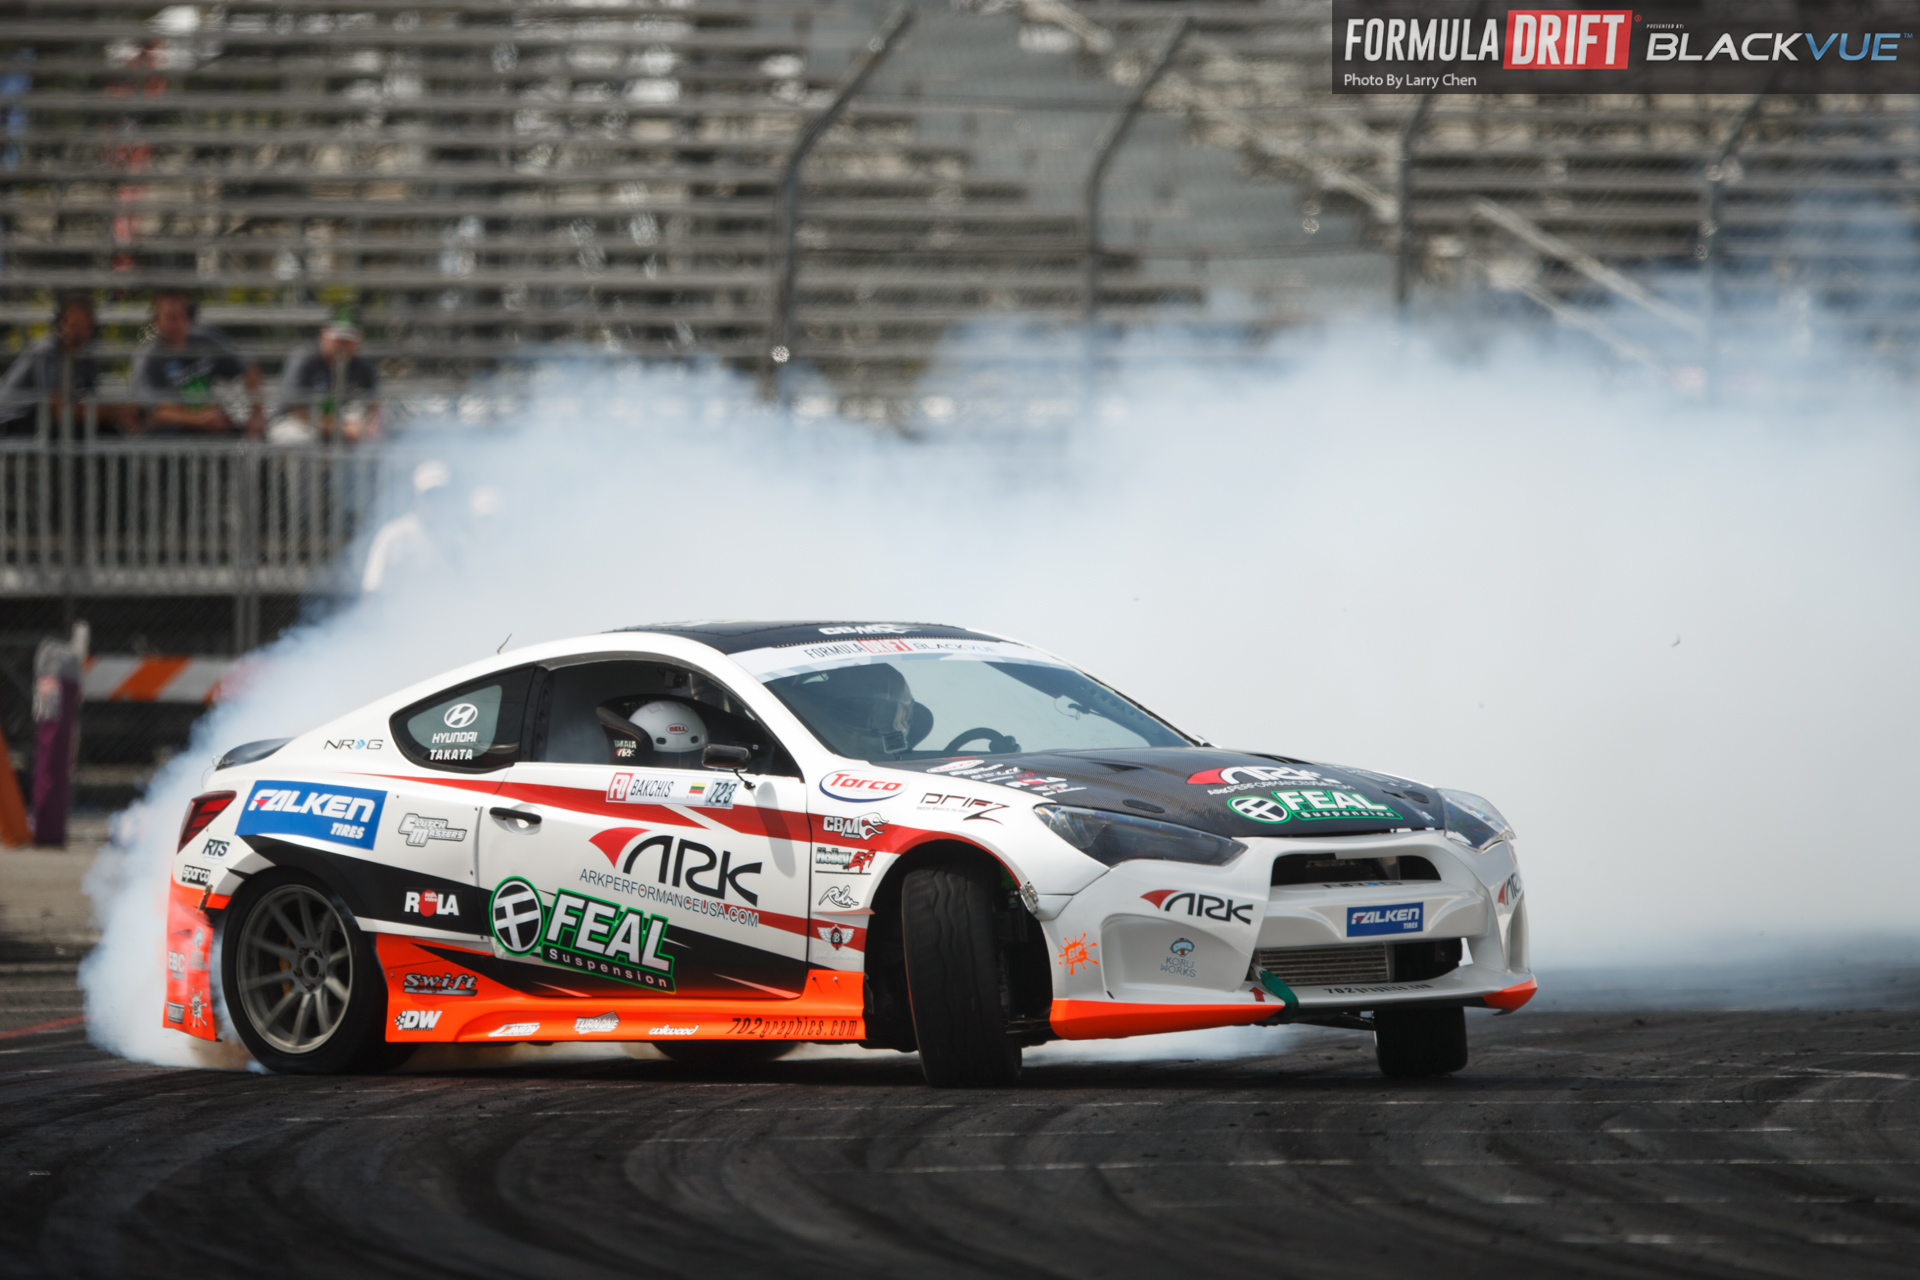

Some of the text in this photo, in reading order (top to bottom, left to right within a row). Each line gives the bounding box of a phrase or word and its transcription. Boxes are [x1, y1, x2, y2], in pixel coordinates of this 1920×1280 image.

[803, 642, 867, 660] FORMULA
[432, 731, 478, 744] HYUNDAI
[429, 748, 473, 761] TAKATA
[630, 779, 675, 798] BAKCHIS
[708, 781, 737, 804] 723
[1275, 790, 1388, 811] FEAL
[249, 788, 376, 823] FALKEN
[330, 822, 366, 840] TIRES
[202, 838, 230, 858] RTS
[183, 865, 211, 882] sparco
[578, 867, 760, 929] ARKPERFORMANCEUSA.COM
[1351, 907, 1420, 925] FALKEN
[546, 893, 671, 972] FEAL
[1403, 922, 1419, 930] TIRES
[549, 947, 668, 989] Suspension
[1159, 963, 1197, 978] WORKS
[1165, 956, 1195, 969] KORU
[403, 1010, 443, 1029] DW
[726, 1016, 858, 1038] 702graphics.com
